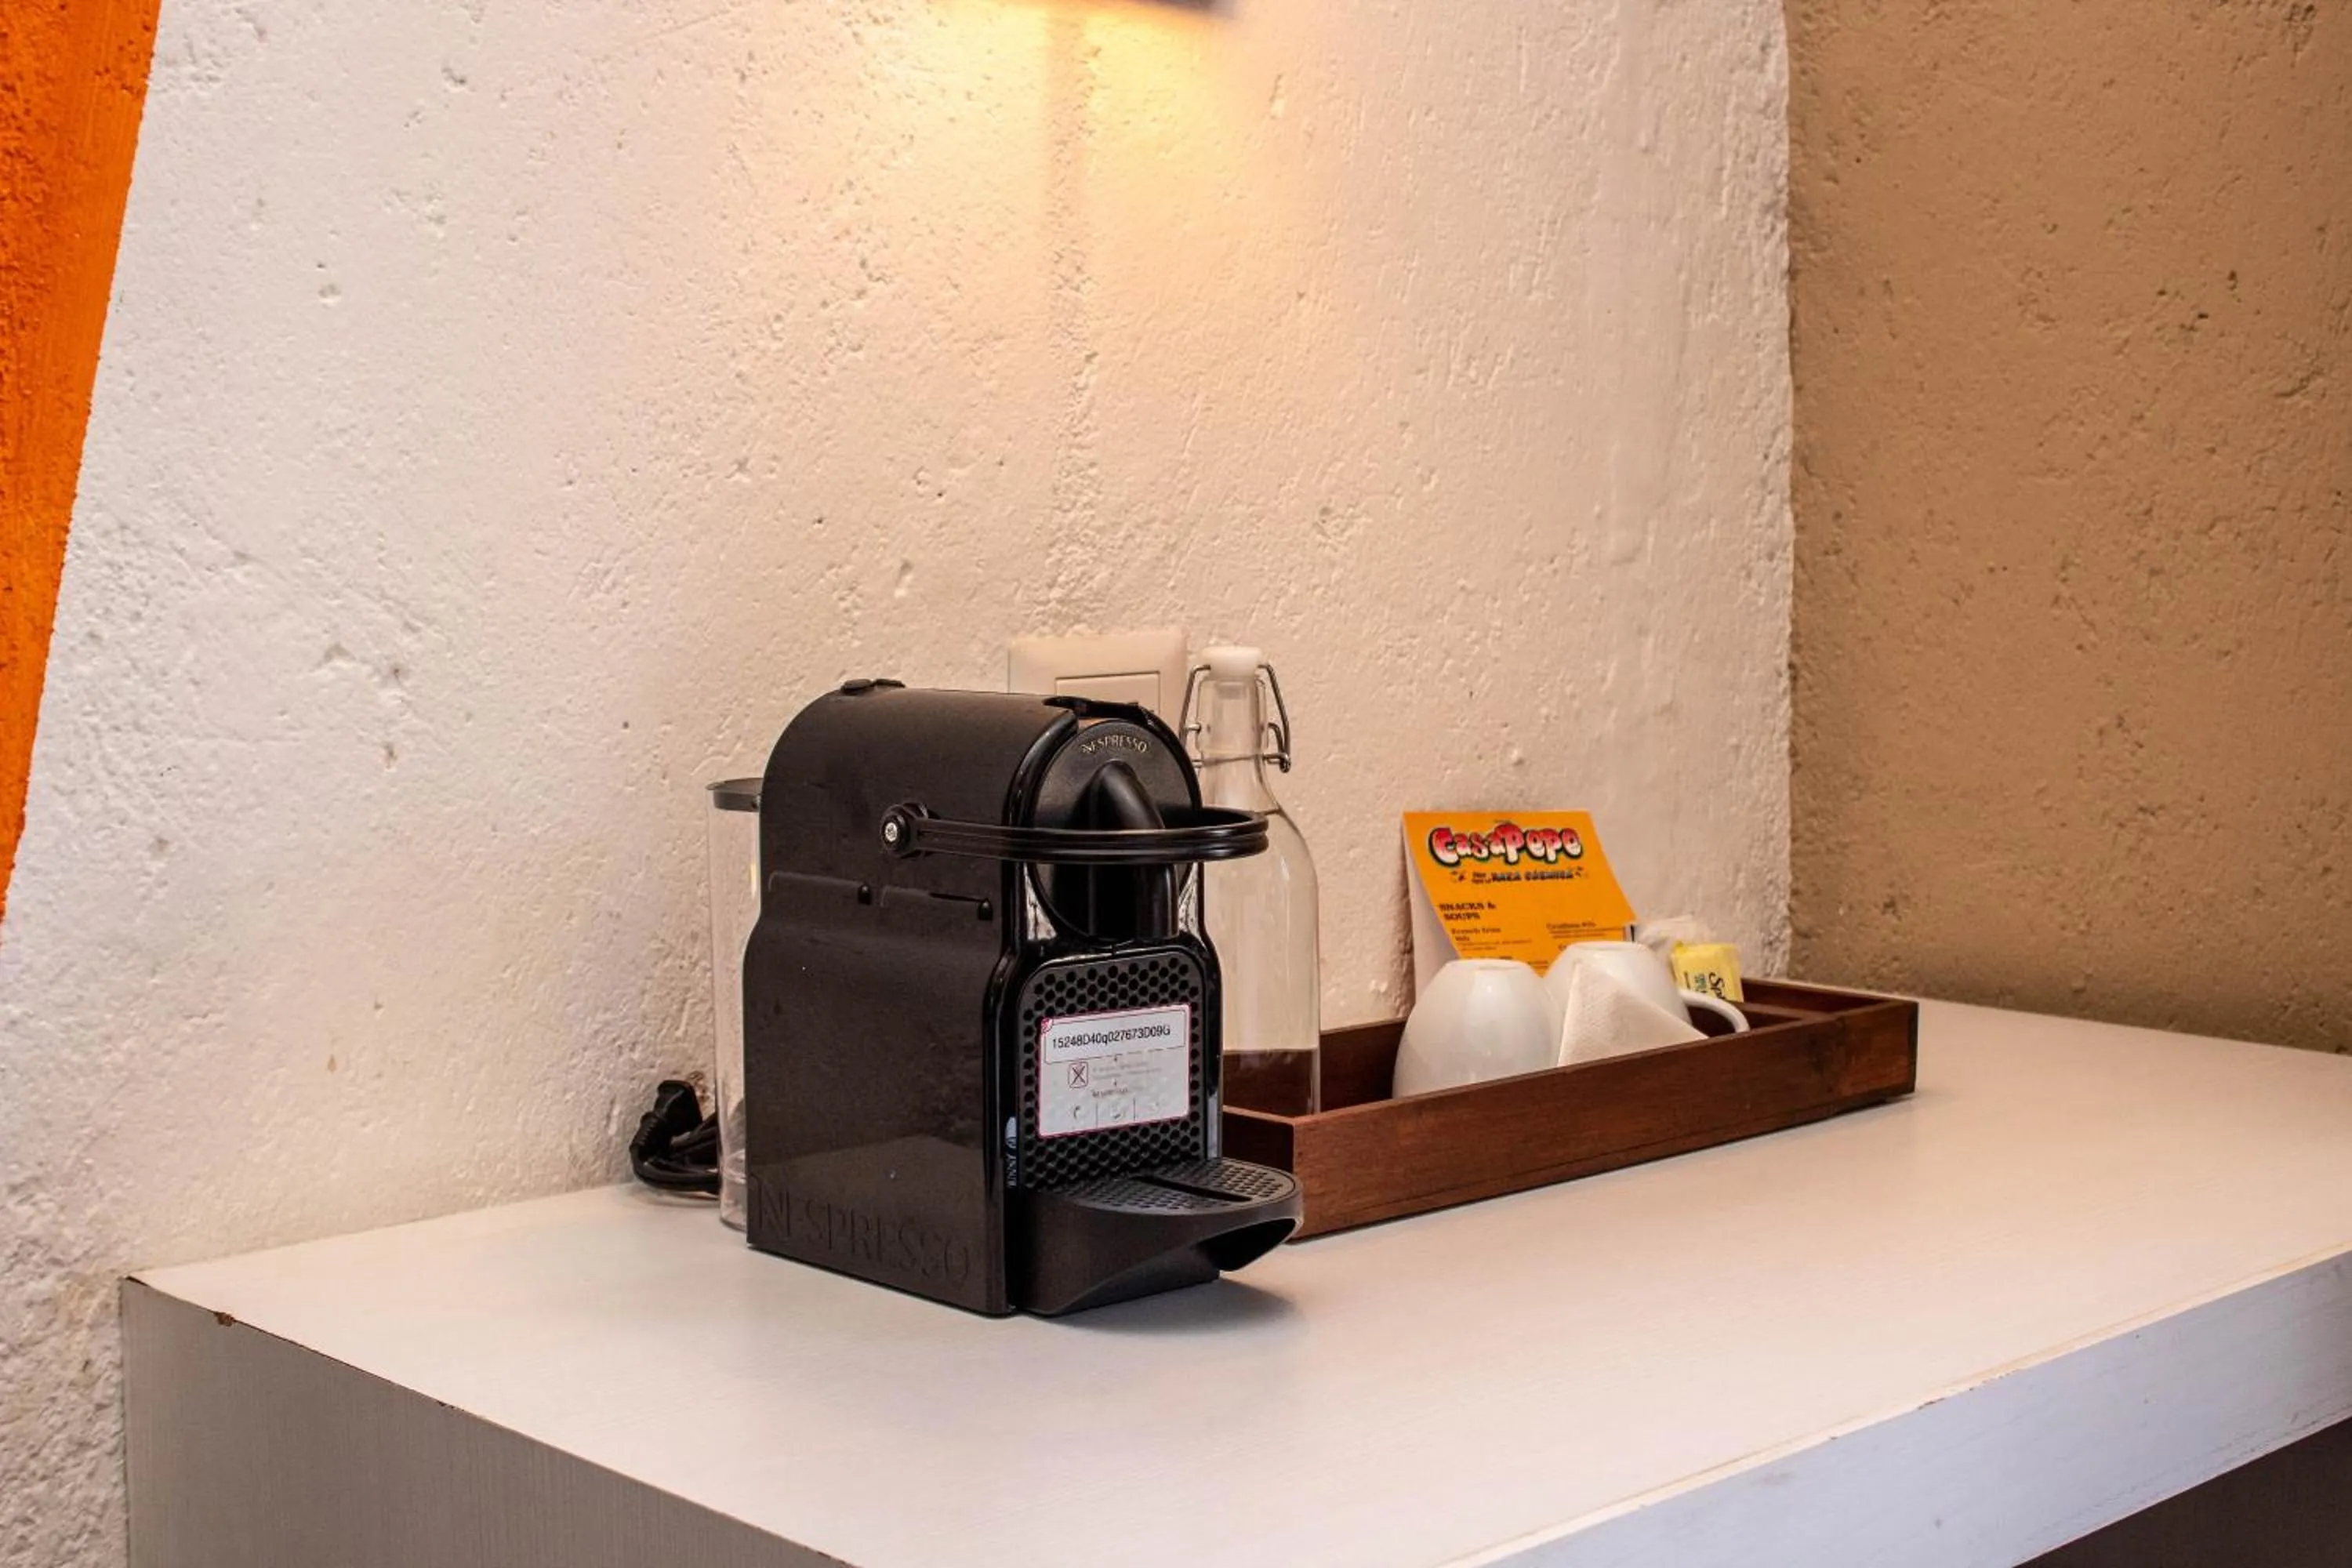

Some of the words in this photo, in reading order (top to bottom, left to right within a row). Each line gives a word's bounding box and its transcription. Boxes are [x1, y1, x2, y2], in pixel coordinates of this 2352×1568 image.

[1080, 734, 1148, 753] NESPRESSO
[1444, 912, 1480, 920] SOUPS
[749, 1173, 970, 1284] NESPRESSO
